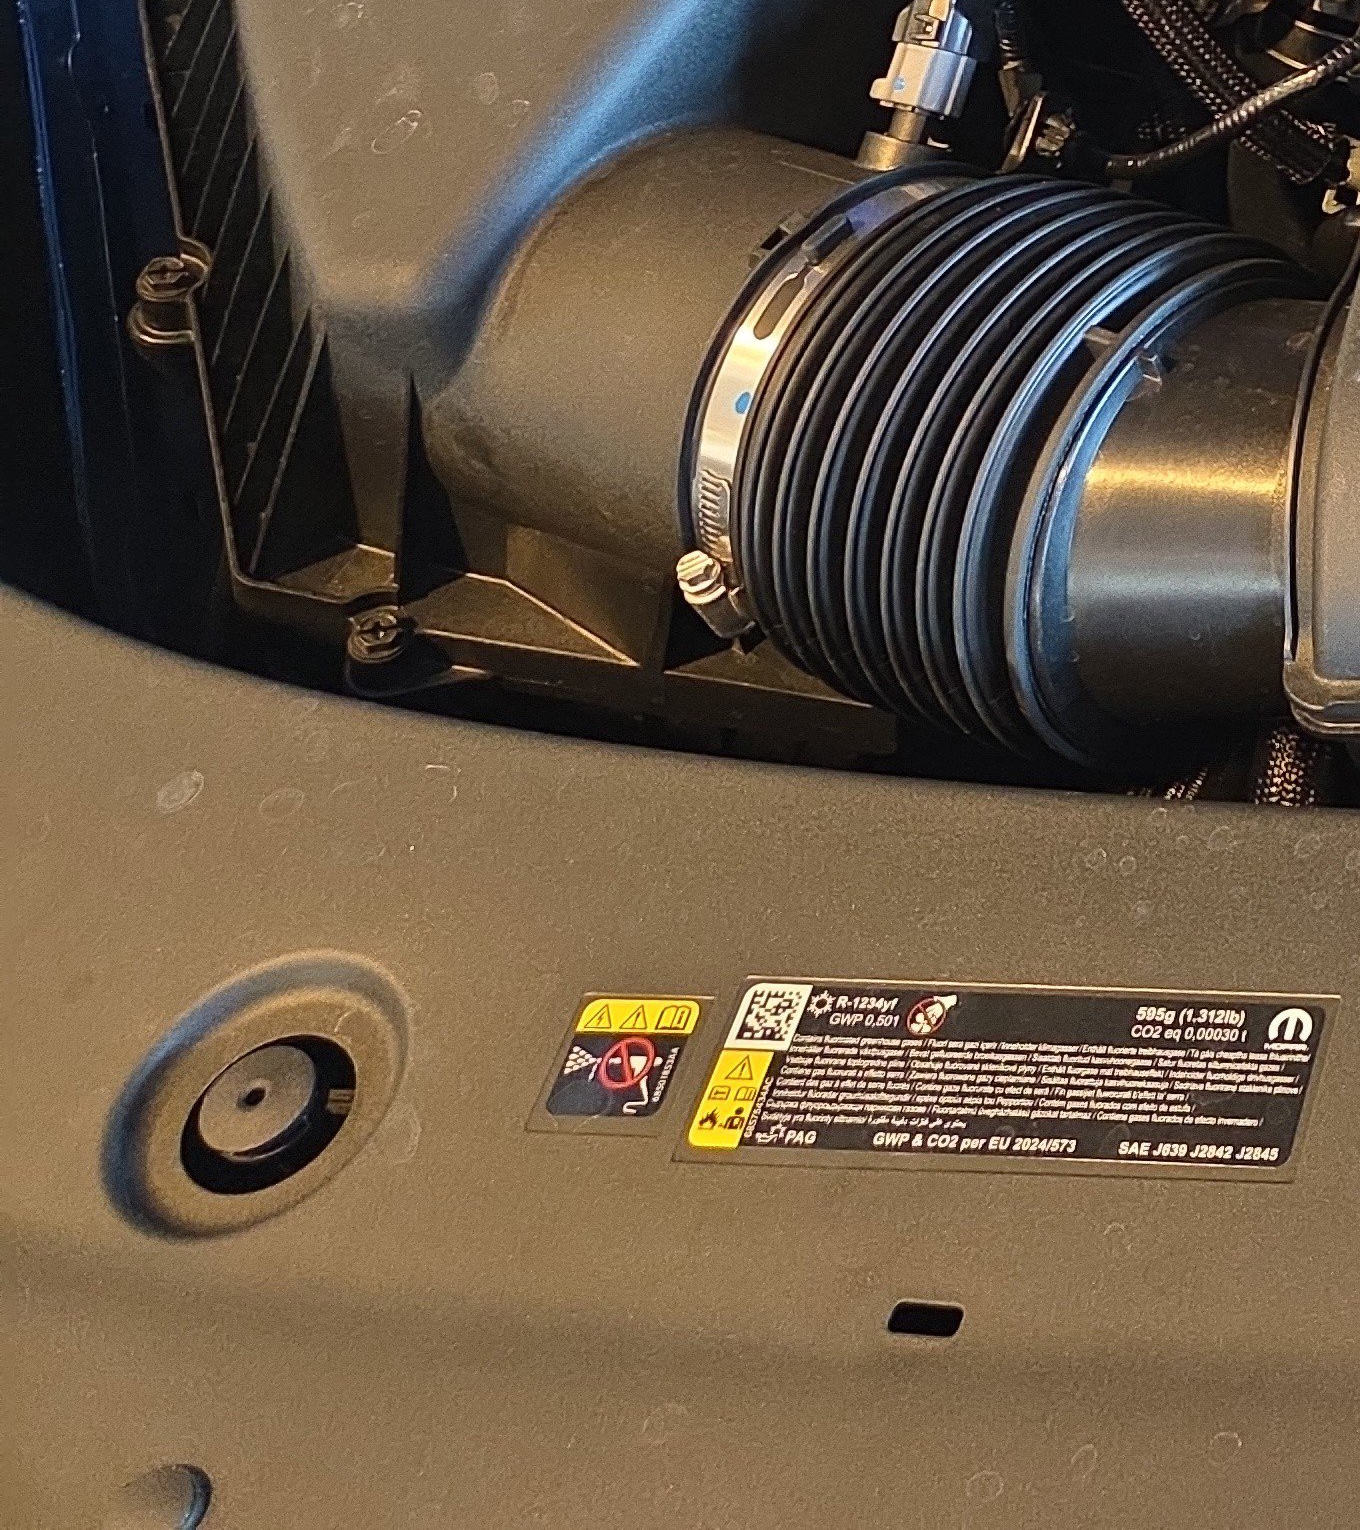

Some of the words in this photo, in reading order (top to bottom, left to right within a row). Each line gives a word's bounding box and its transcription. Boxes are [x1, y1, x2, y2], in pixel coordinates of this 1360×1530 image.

[835, 995, 899, 1013] R-1234yf
[829, 1013, 863, 1027] GWP
[1136, 1006, 1176, 1025] 595g
[1131, 1024, 1162, 1039] CO2
[1164, 1027, 1181, 1043] eq
[784, 1130, 817, 1145] PAG
[873, 1131, 910, 1147] GWP
[912, 1133, 923, 1147] &
[927, 1134, 959, 1149] CO2
[960, 1137, 986, 1153] per
[988, 1136, 1012, 1150] EU
[1012, 1137, 1077, 1154] 2024/573
[1118, 1141, 1151, 1156] SAE
[1153, 1142, 1188, 1158] J639
